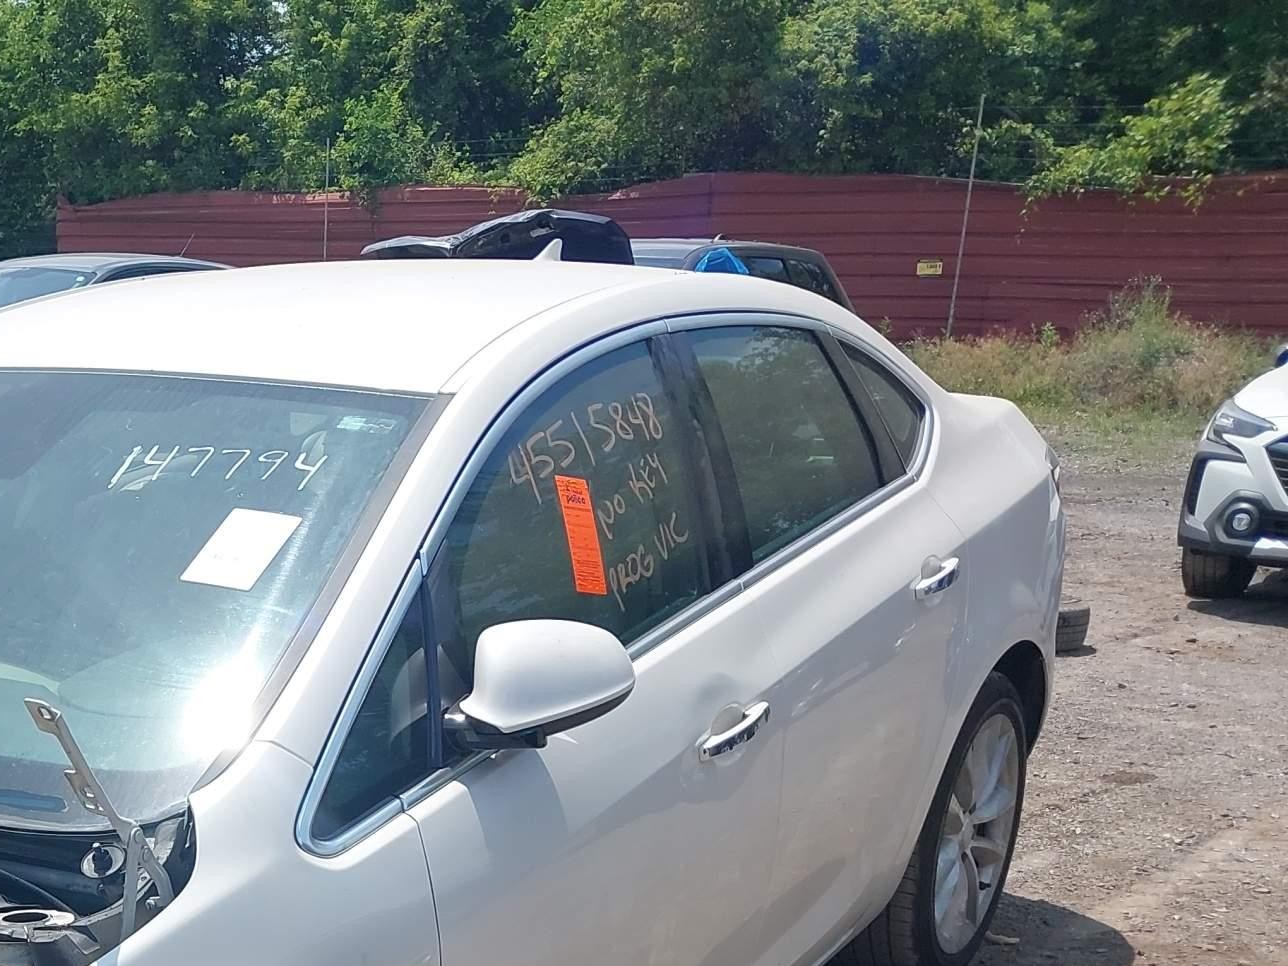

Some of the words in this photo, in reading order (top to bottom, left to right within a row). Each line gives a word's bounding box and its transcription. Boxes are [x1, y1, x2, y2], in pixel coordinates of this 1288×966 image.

[107, 444, 329, 491] 147794
[509, 393, 662, 504] 45515848
[596, 494, 626, 540] NO
[628, 452, 668, 504] KEY
